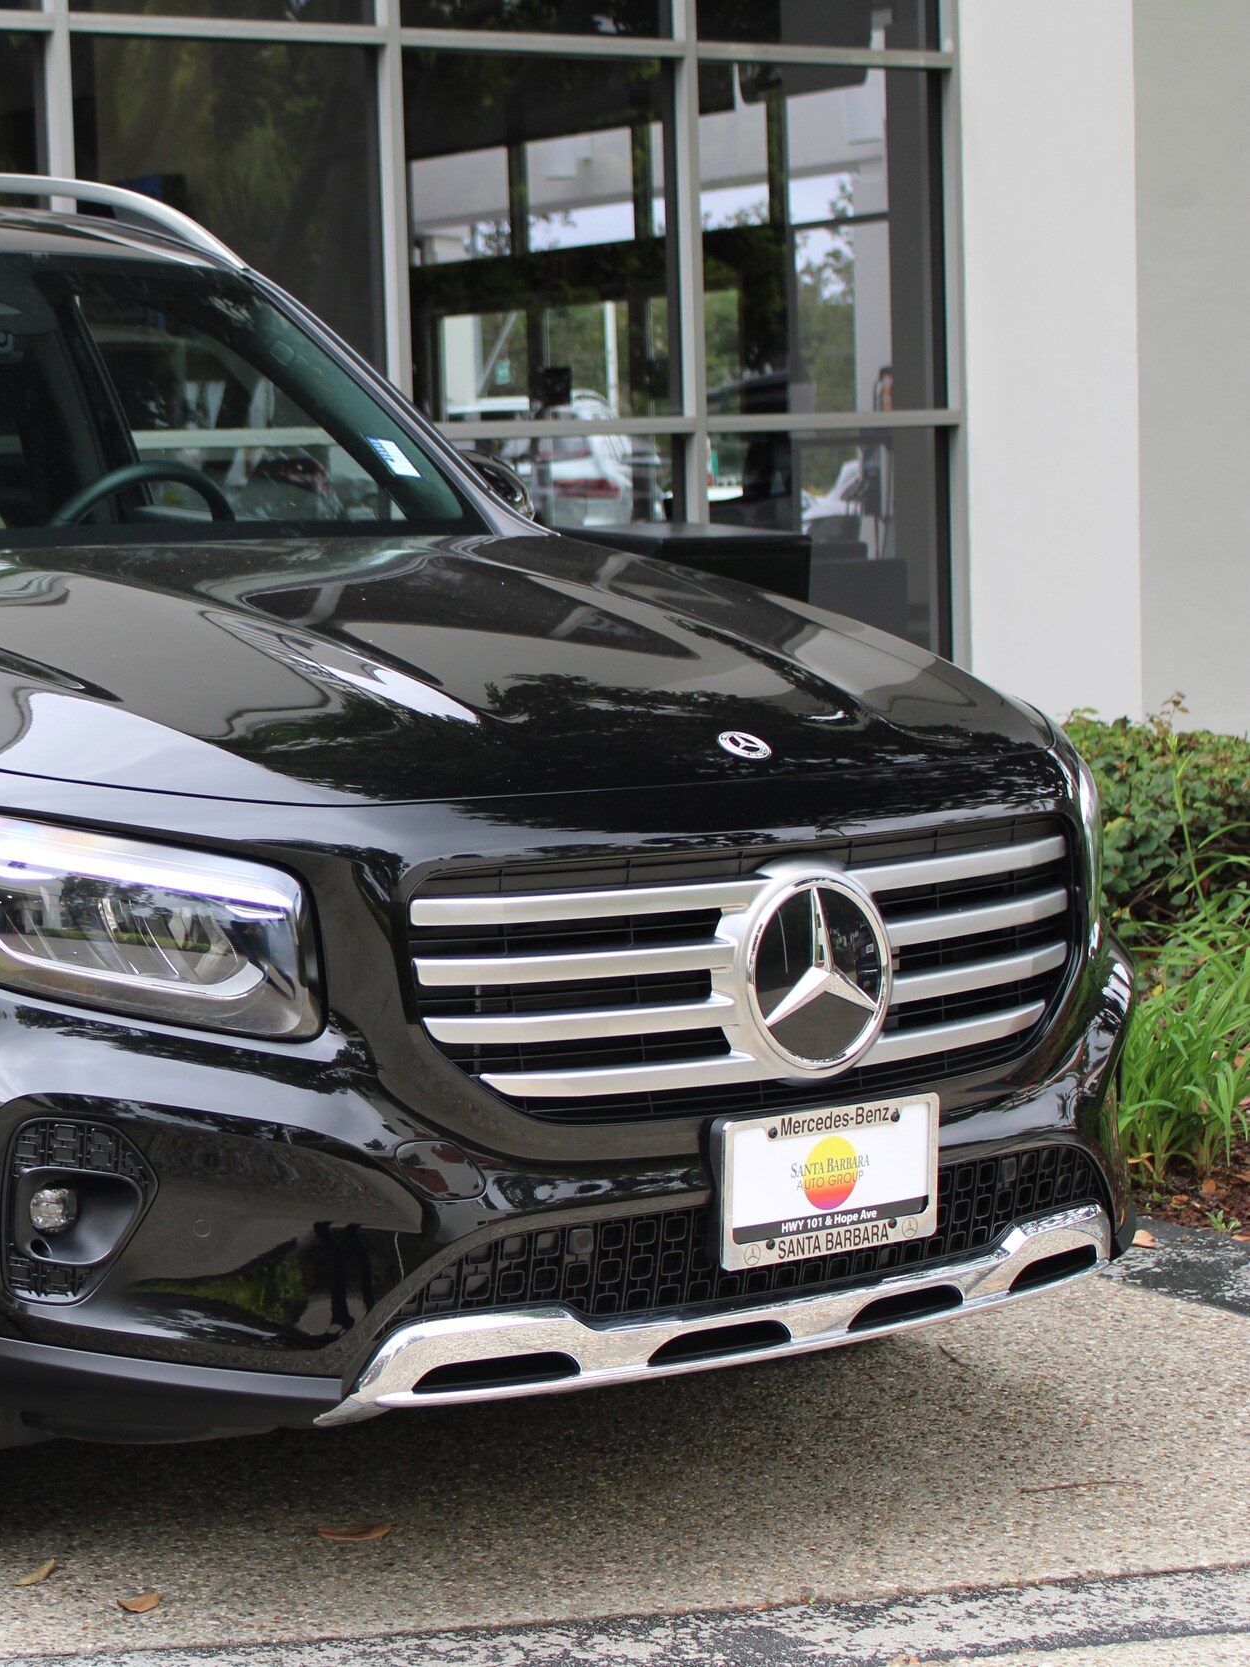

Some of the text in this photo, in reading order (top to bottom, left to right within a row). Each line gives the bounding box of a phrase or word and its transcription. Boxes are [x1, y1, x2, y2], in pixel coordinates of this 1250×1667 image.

[780, 1106, 890, 1137] Mercedes-Benz
[790, 1154, 870, 1179] SANTA BARBARA
[796, 1170, 864, 1191] AUTO GROUP
[781, 1209, 877, 1233] HWY 101 & Hope Ave
[778, 1222, 889, 1259] SANTA BARBARA
